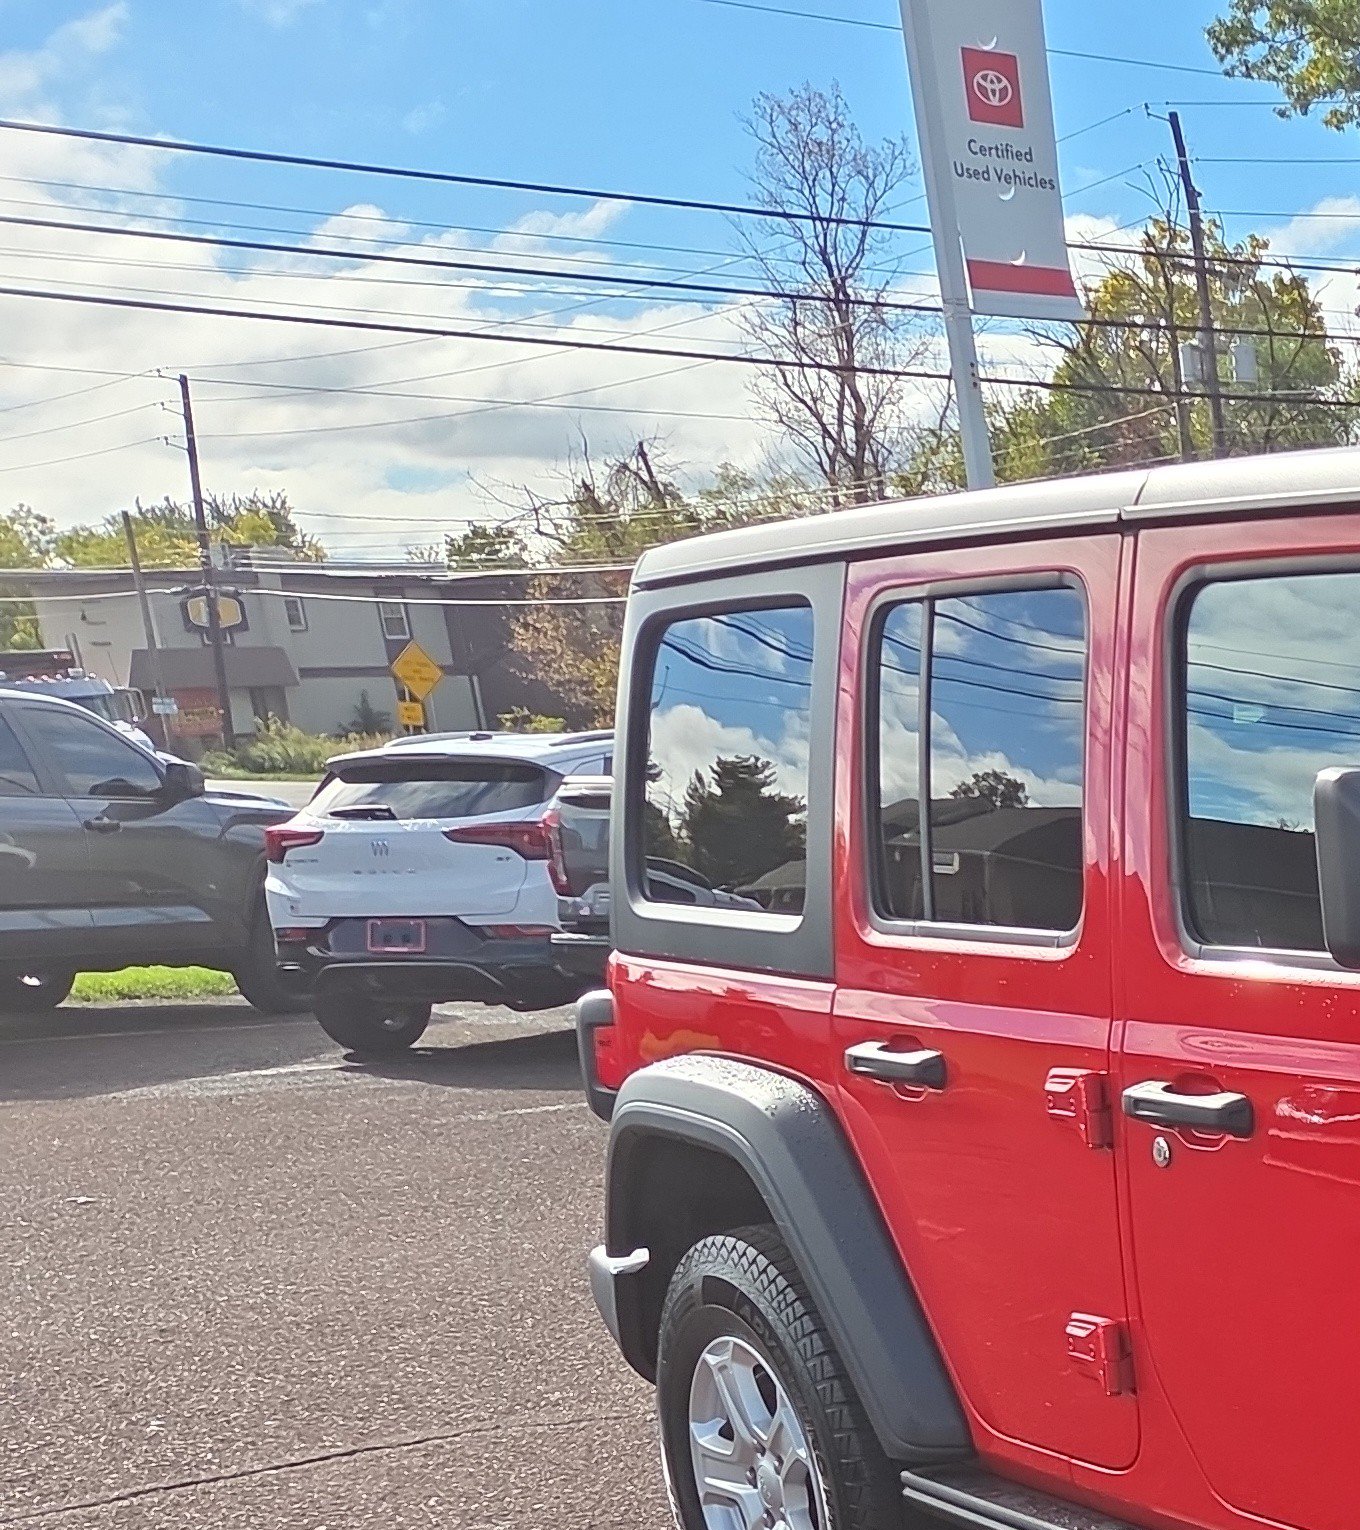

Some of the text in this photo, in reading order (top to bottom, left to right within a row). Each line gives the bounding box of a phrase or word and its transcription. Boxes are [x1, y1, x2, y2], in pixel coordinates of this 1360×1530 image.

[967, 138, 1033, 163] Certified
[953, 161, 1056, 191] Used Vehicles
